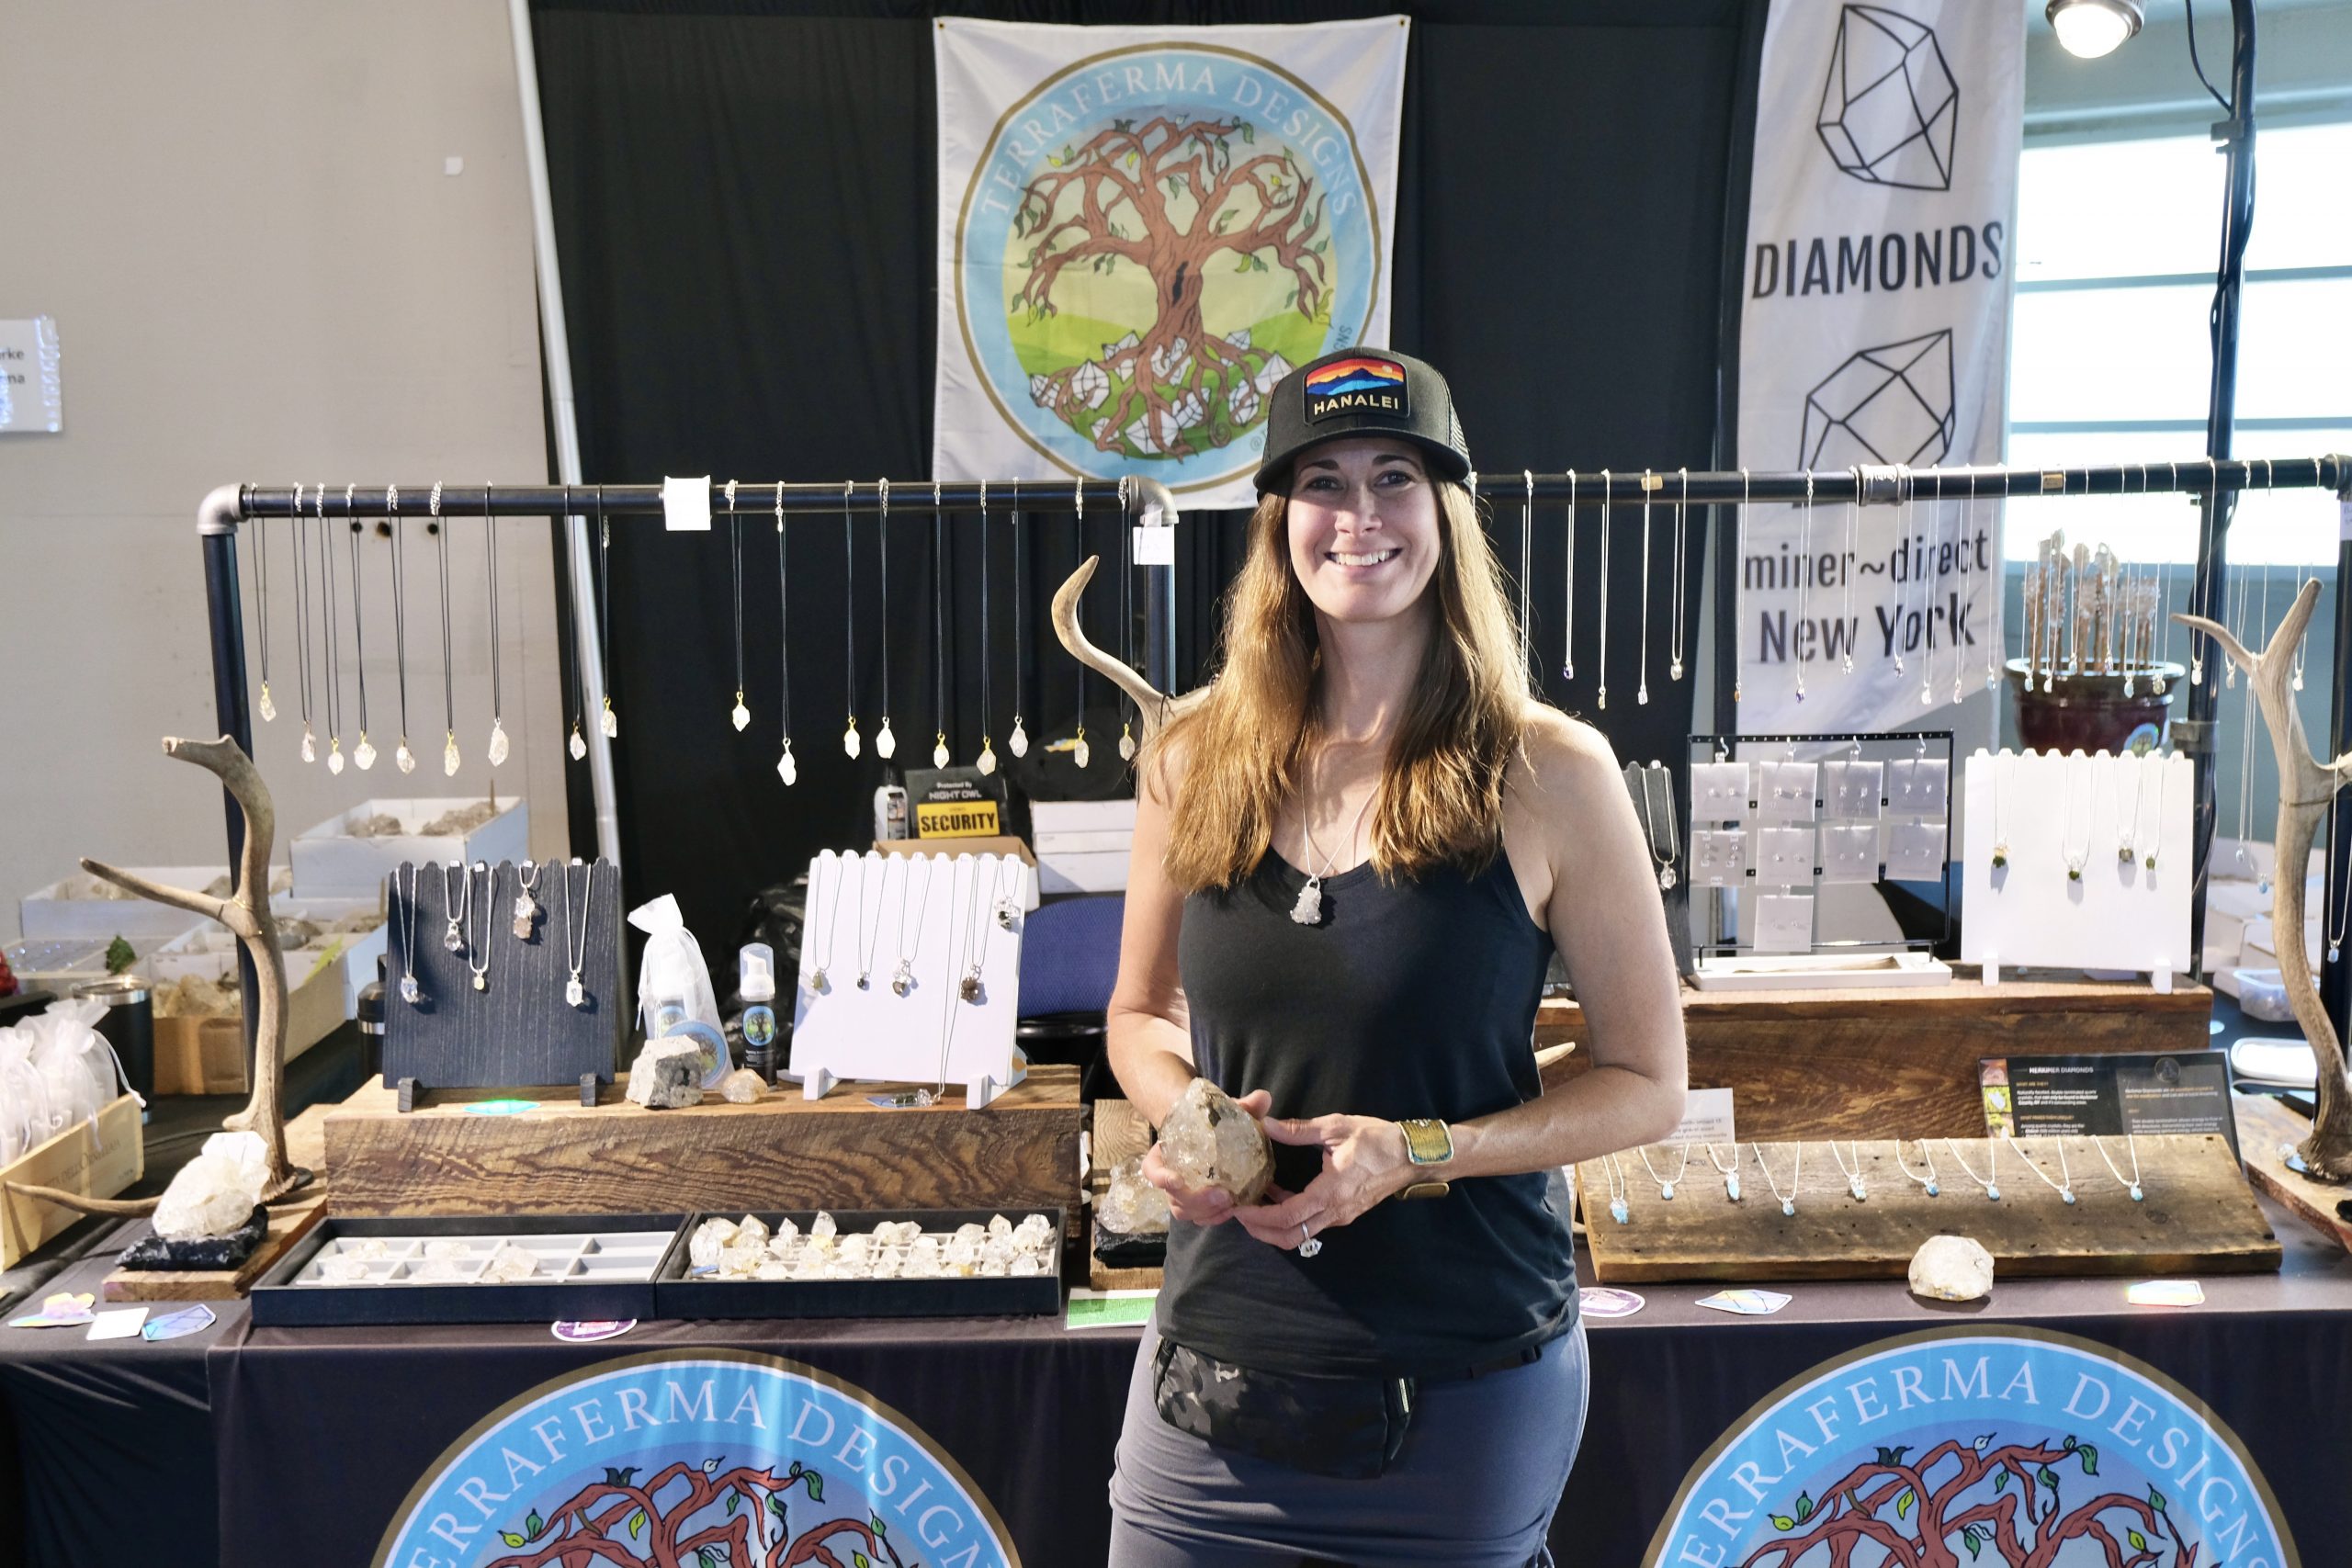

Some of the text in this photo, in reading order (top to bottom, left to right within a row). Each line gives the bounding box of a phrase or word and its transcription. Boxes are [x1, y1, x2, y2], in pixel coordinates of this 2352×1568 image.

[980, 62, 1357, 216] TERRAFERMA DESIGNS
[1751, 221, 2004, 299] DIAMONDS
[1314, 393, 1399, 416] HANALEI
[1744, 528, 1989, 591] miner~direct
[1759, 592, 1976, 663] New York
[921, 812, 996, 833] SECURITY
[928, 789, 982, 801] NIGHT OWL
[407, 1379, 993, 1568] ERRAFERMA DESIGN
[1677, 1355, 2270, 1568] ERRAFERMA DESIGN
